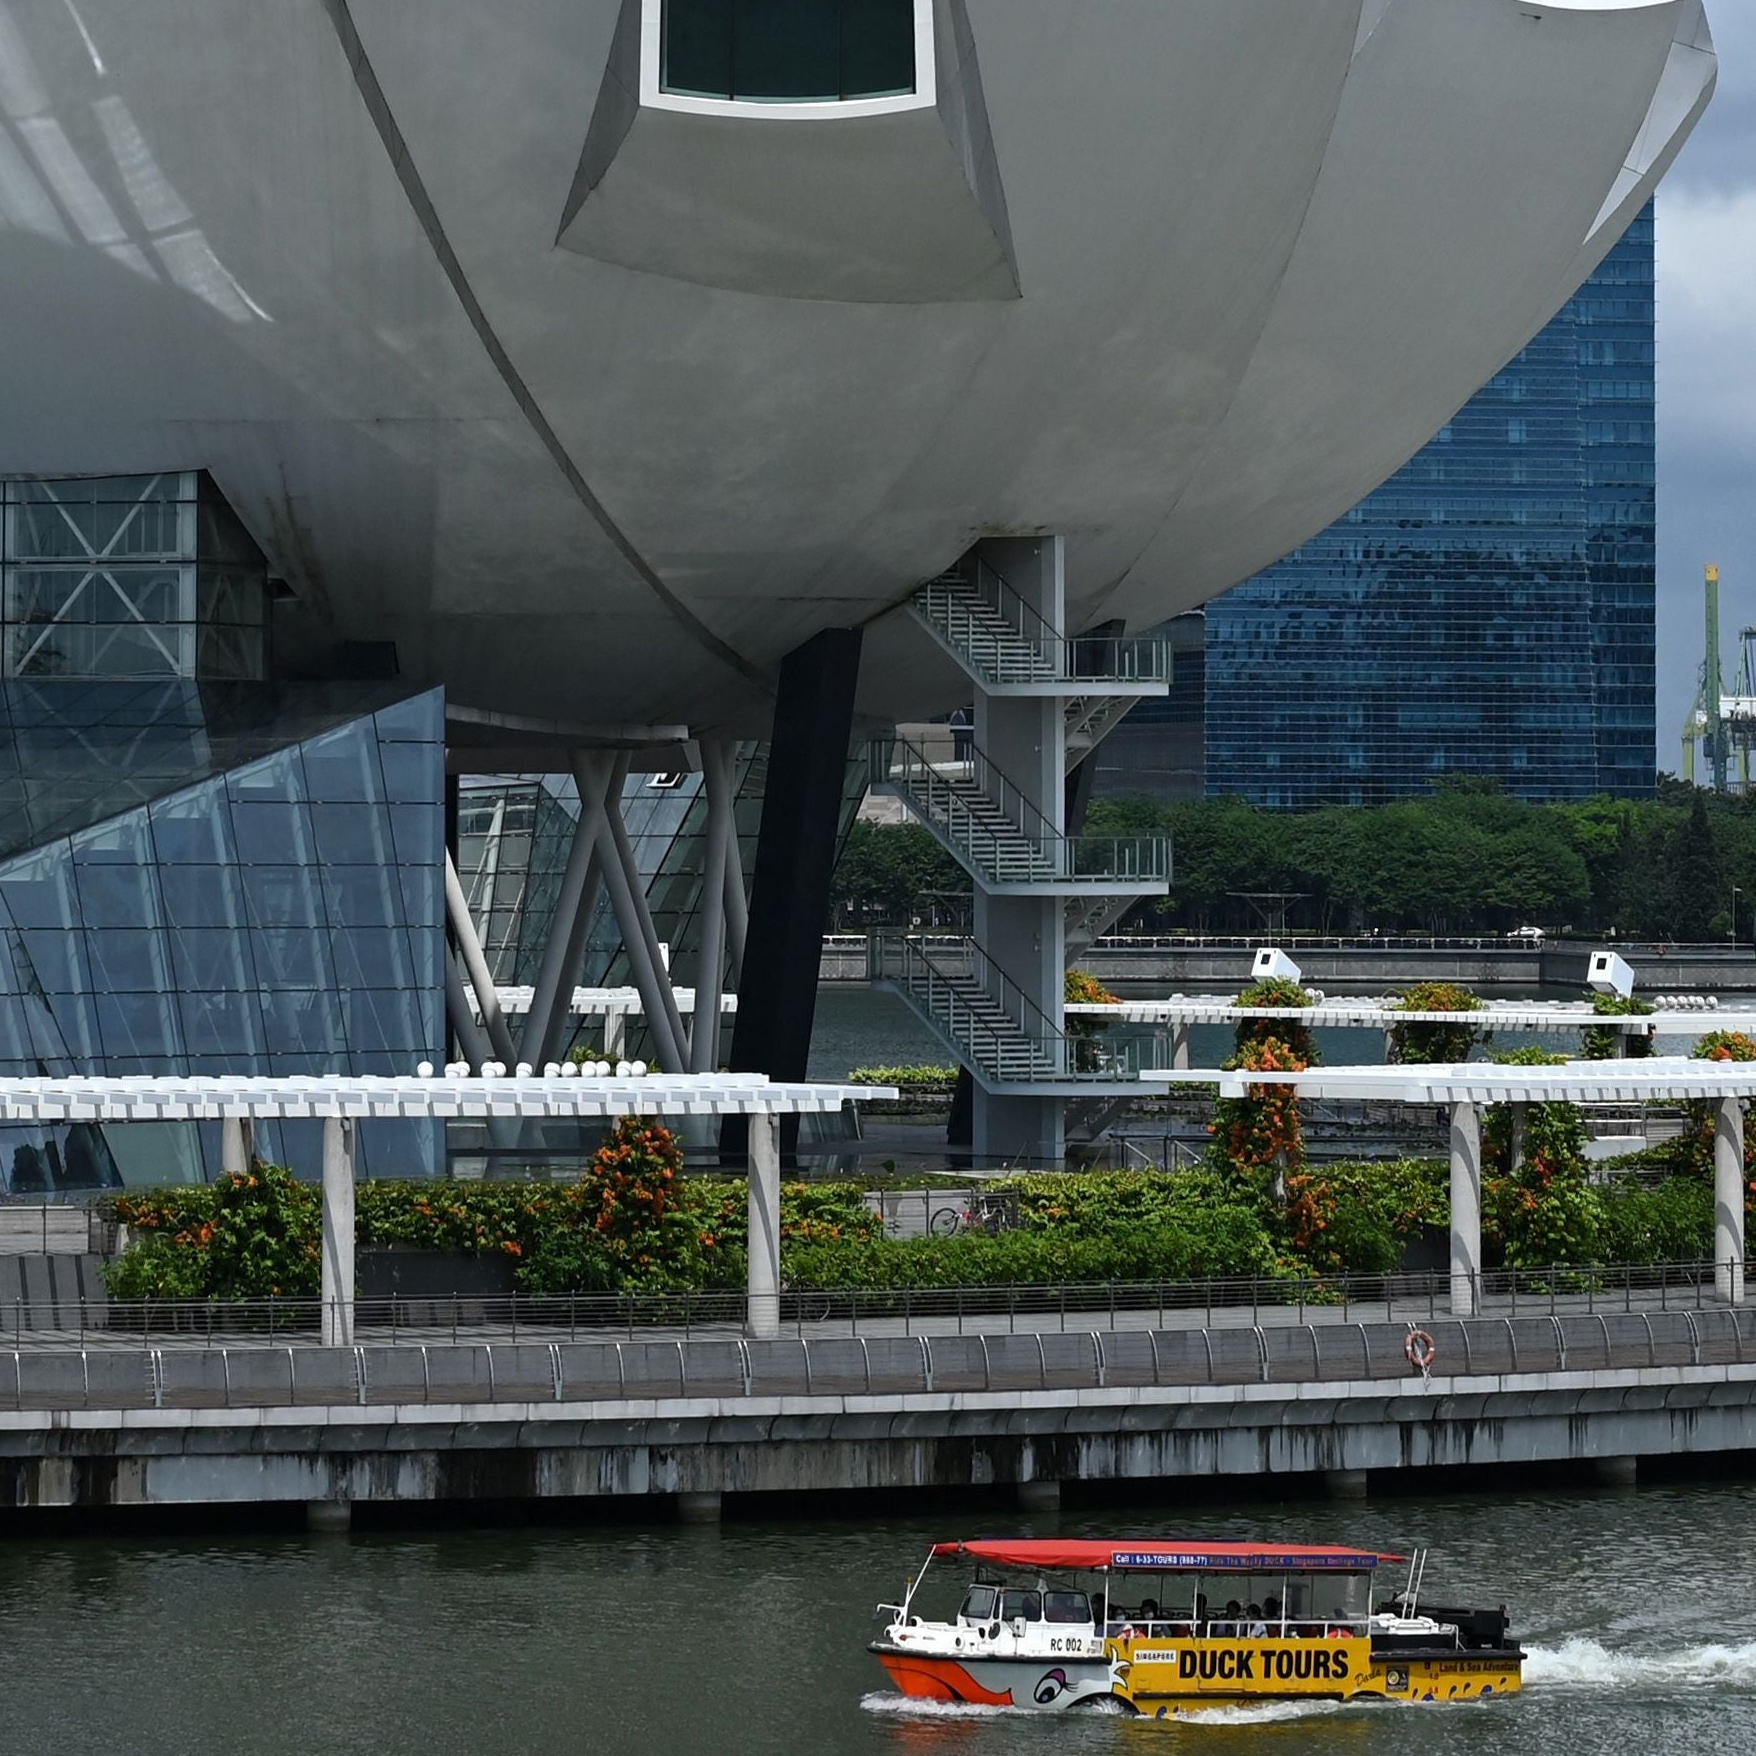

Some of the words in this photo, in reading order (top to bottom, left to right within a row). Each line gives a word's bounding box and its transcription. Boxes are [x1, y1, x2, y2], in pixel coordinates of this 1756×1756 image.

[1050, 1638, 1063, 1651] RC
[1065, 1638, 1082, 1651] 002
[1179, 1649, 1255, 1679] DUCK
[1260, 1649, 1349, 1679] TOURS
[1439, 1662, 1458, 1672] Land
